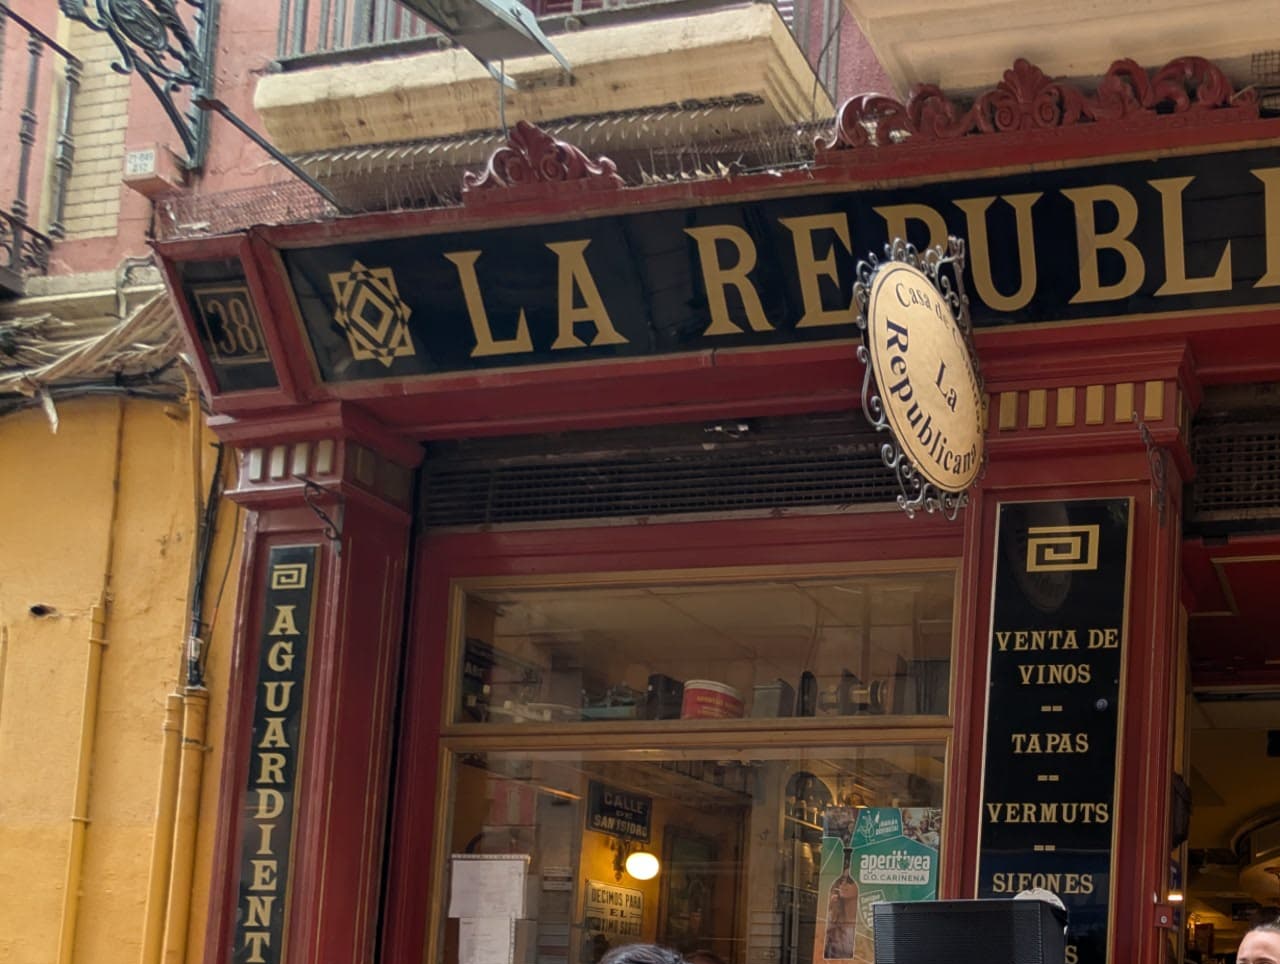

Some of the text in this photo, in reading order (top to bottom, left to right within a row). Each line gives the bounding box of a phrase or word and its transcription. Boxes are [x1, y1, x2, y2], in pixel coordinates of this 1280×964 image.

[444, 238, 629, 358] LA
[895, 282, 932, 313] Casa
[207, 298, 257, 354] 38
[934, 359, 958, 414] La
[995, 628, 1119, 651] VENTA DE
[1018, 664, 1091, 685] VINOS
[1011, 733, 1089, 754] TAPAS
[986, 802, 1109, 824] VERMUTS
[992, 873, 1094, 894] SIFONES
[610, 908, 627, 918] EL
